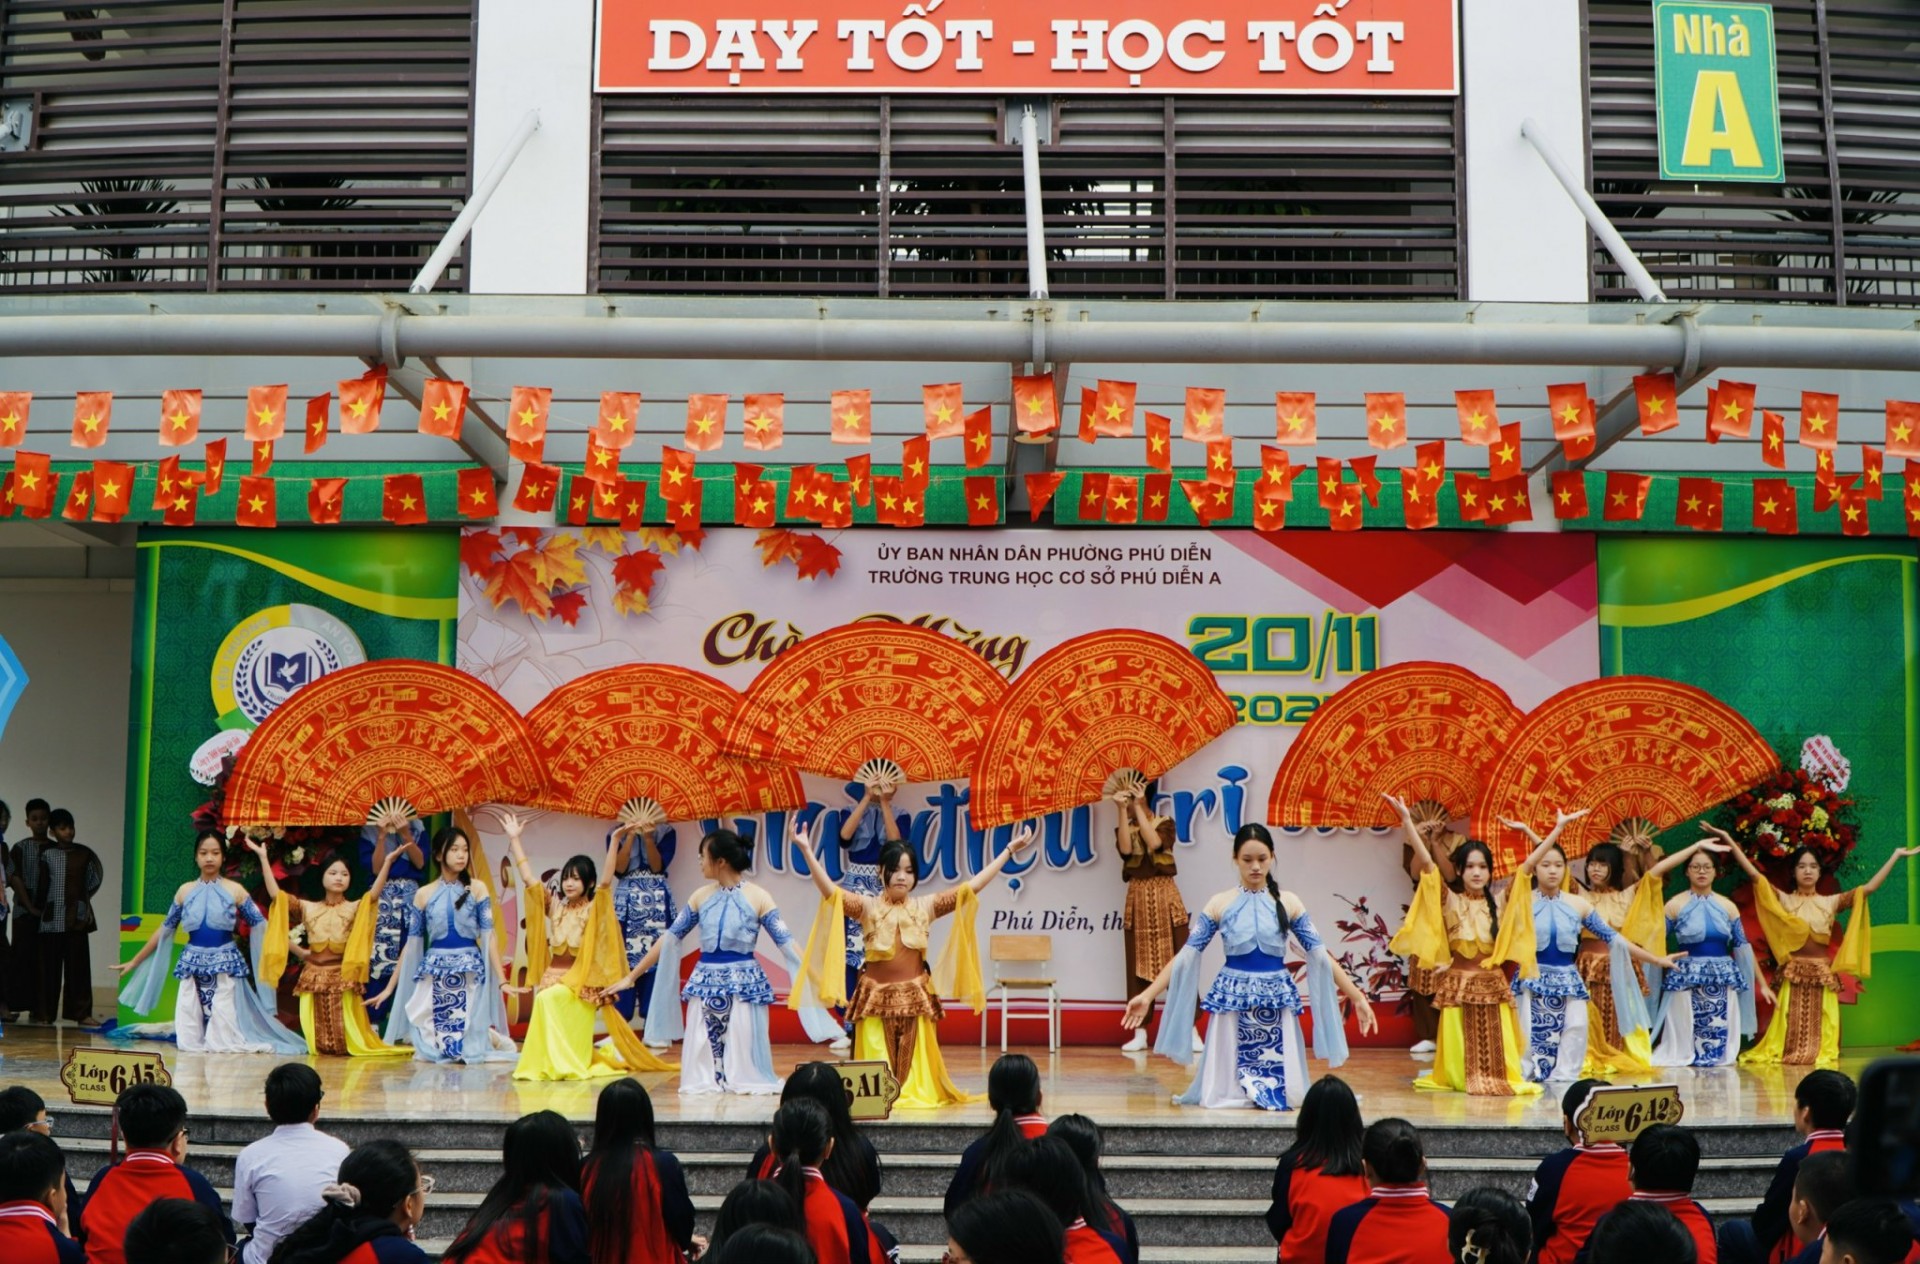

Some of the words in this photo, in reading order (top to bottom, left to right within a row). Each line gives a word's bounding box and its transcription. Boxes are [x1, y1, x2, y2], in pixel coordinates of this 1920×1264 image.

[648, 19, 818, 85] DẠY
[837, 0, 993, 71] TỐT
[1051, 18, 1226, 87] HỌC
[1247, 0, 1404, 72] TỐT
[1673, 13, 1751, 57] Nhà
[1681, 70, 1764, 168] A
[878, 542, 901, 561] ỦY
[907, 547, 943, 561] BAN
[949, 544, 999, 561] NHÂN
[1004, 544, 1041, 561] DÂN
[1047, 543, 1123, 561] PHƯỜNG
[1129, 544, 1165, 561] PHÚ
[1170, 542, 1212, 561] DIỄN
[868, 565, 943, 584] TRƯỜNG
[949, 571, 1010, 585] TRUNG
[1016, 571, 1054, 588] HỌC
[1059, 570, 1085, 585] CƠ
[1090, 565, 1115, 585] SỞ
[1121, 568, 1157, 585] PHÚ
[1162, 565, 1204, 585] DIỄN
[1208, 571, 1222, 585] A
[1188, 609, 1378, 682] 20/11
[990, 910, 1034, 931] Phú
[1040, 906, 1094, 934] Diễn,
[80, 1063, 108, 1082] Lớp
[80, 1083, 106, 1092] CLASS
[1594, 1125, 1620, 1133] CLASS
[1597, 1105, 1625, 1123] Lớp
[1624, 1097, 1670, 1133] 6A2
